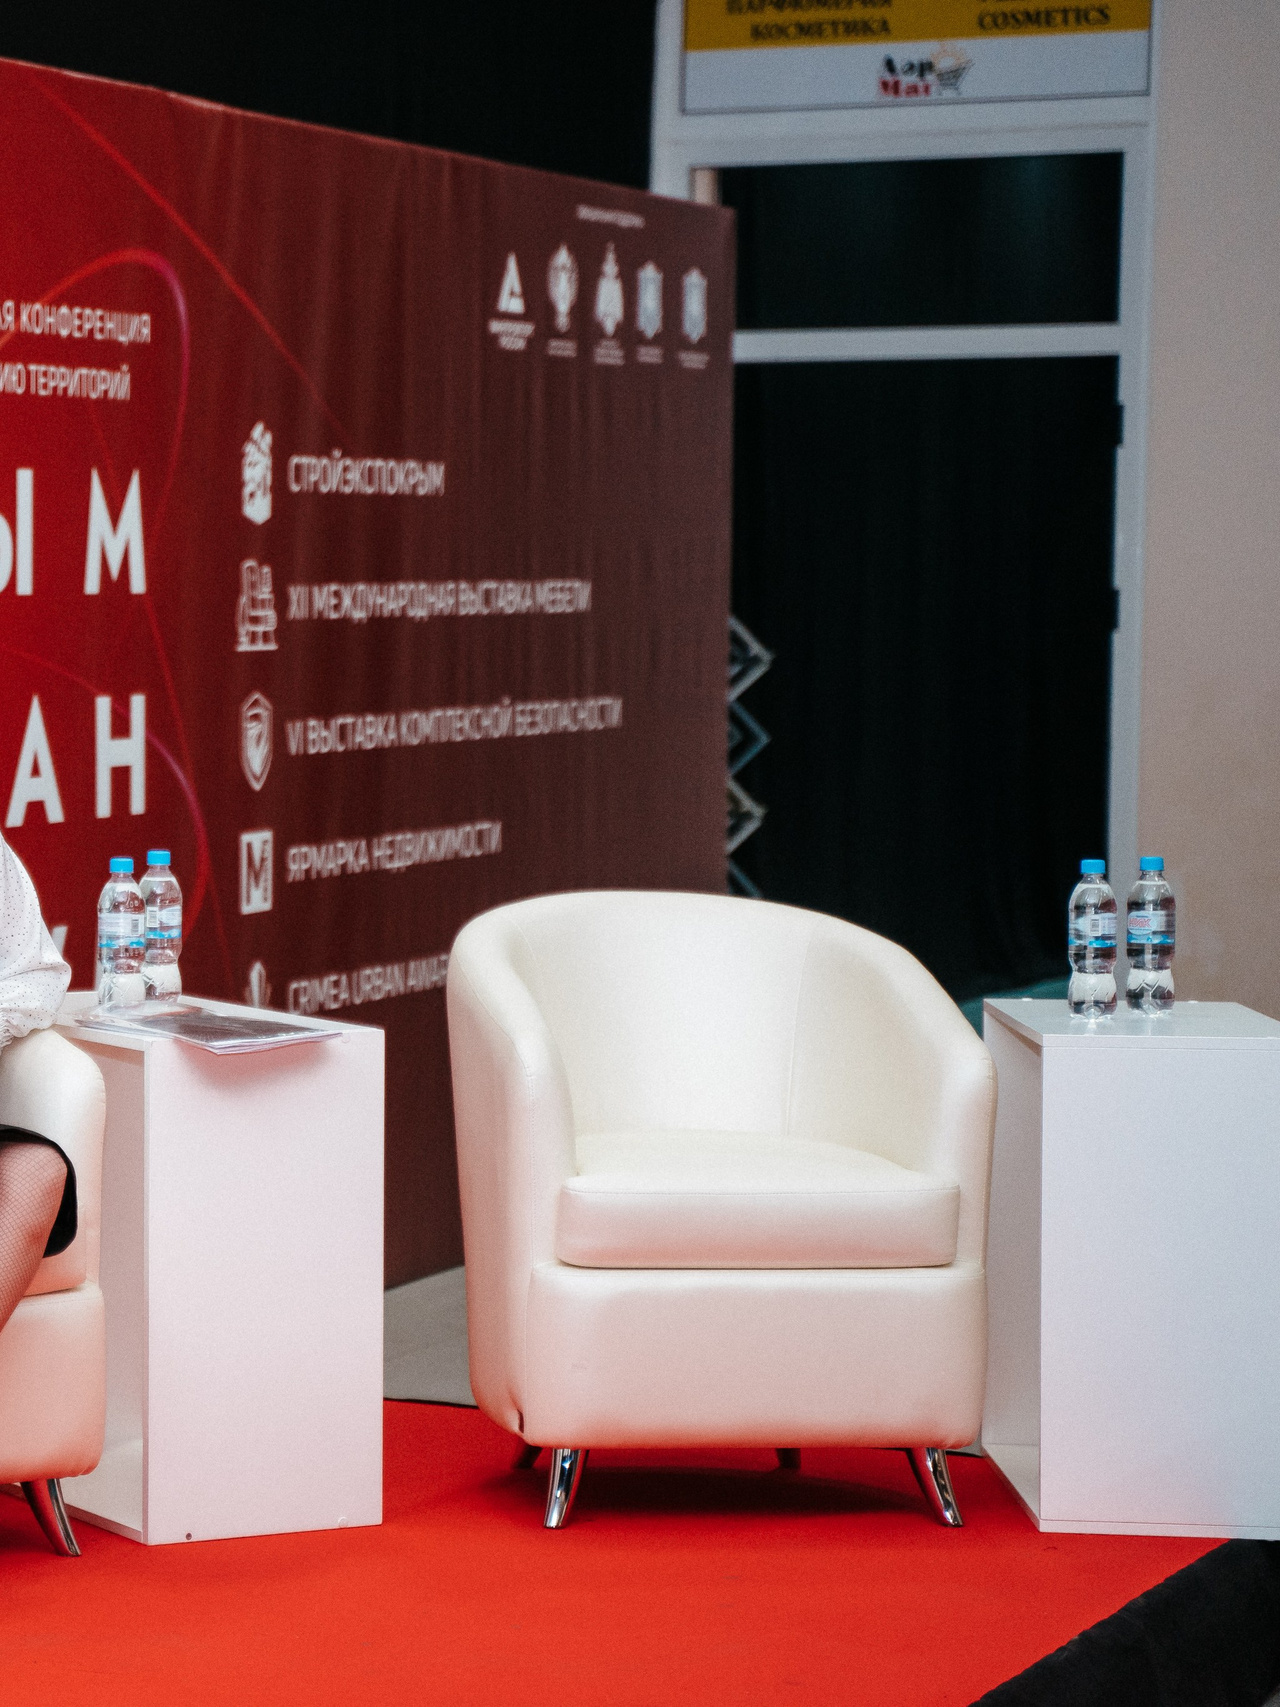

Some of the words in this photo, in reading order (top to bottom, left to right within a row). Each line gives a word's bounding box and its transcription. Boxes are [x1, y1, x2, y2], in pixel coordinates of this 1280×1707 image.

[750, 18, 890, 40] КОСМЕТИКА
[977, 4, 1112, 30] COSMETICS
[20, 303, 151, 344] КОНФЕРЕНЦИЯ
[28, 364, 131, 401] ТЕРРИТОРИЙ
[287, 448, 445, 497] СТРОЙЭКСПОКРЫМ
[307, 713, 397, 755] ВЫСТАВКА
[288, 838, 369, 883] ЯРМАРКА
[371, 820, 503, 873] НЕДВИЖИМОСТИ
[287, 974, 350, 1015] CRIMEA
[351, 962, 406, 1005] URBAN
